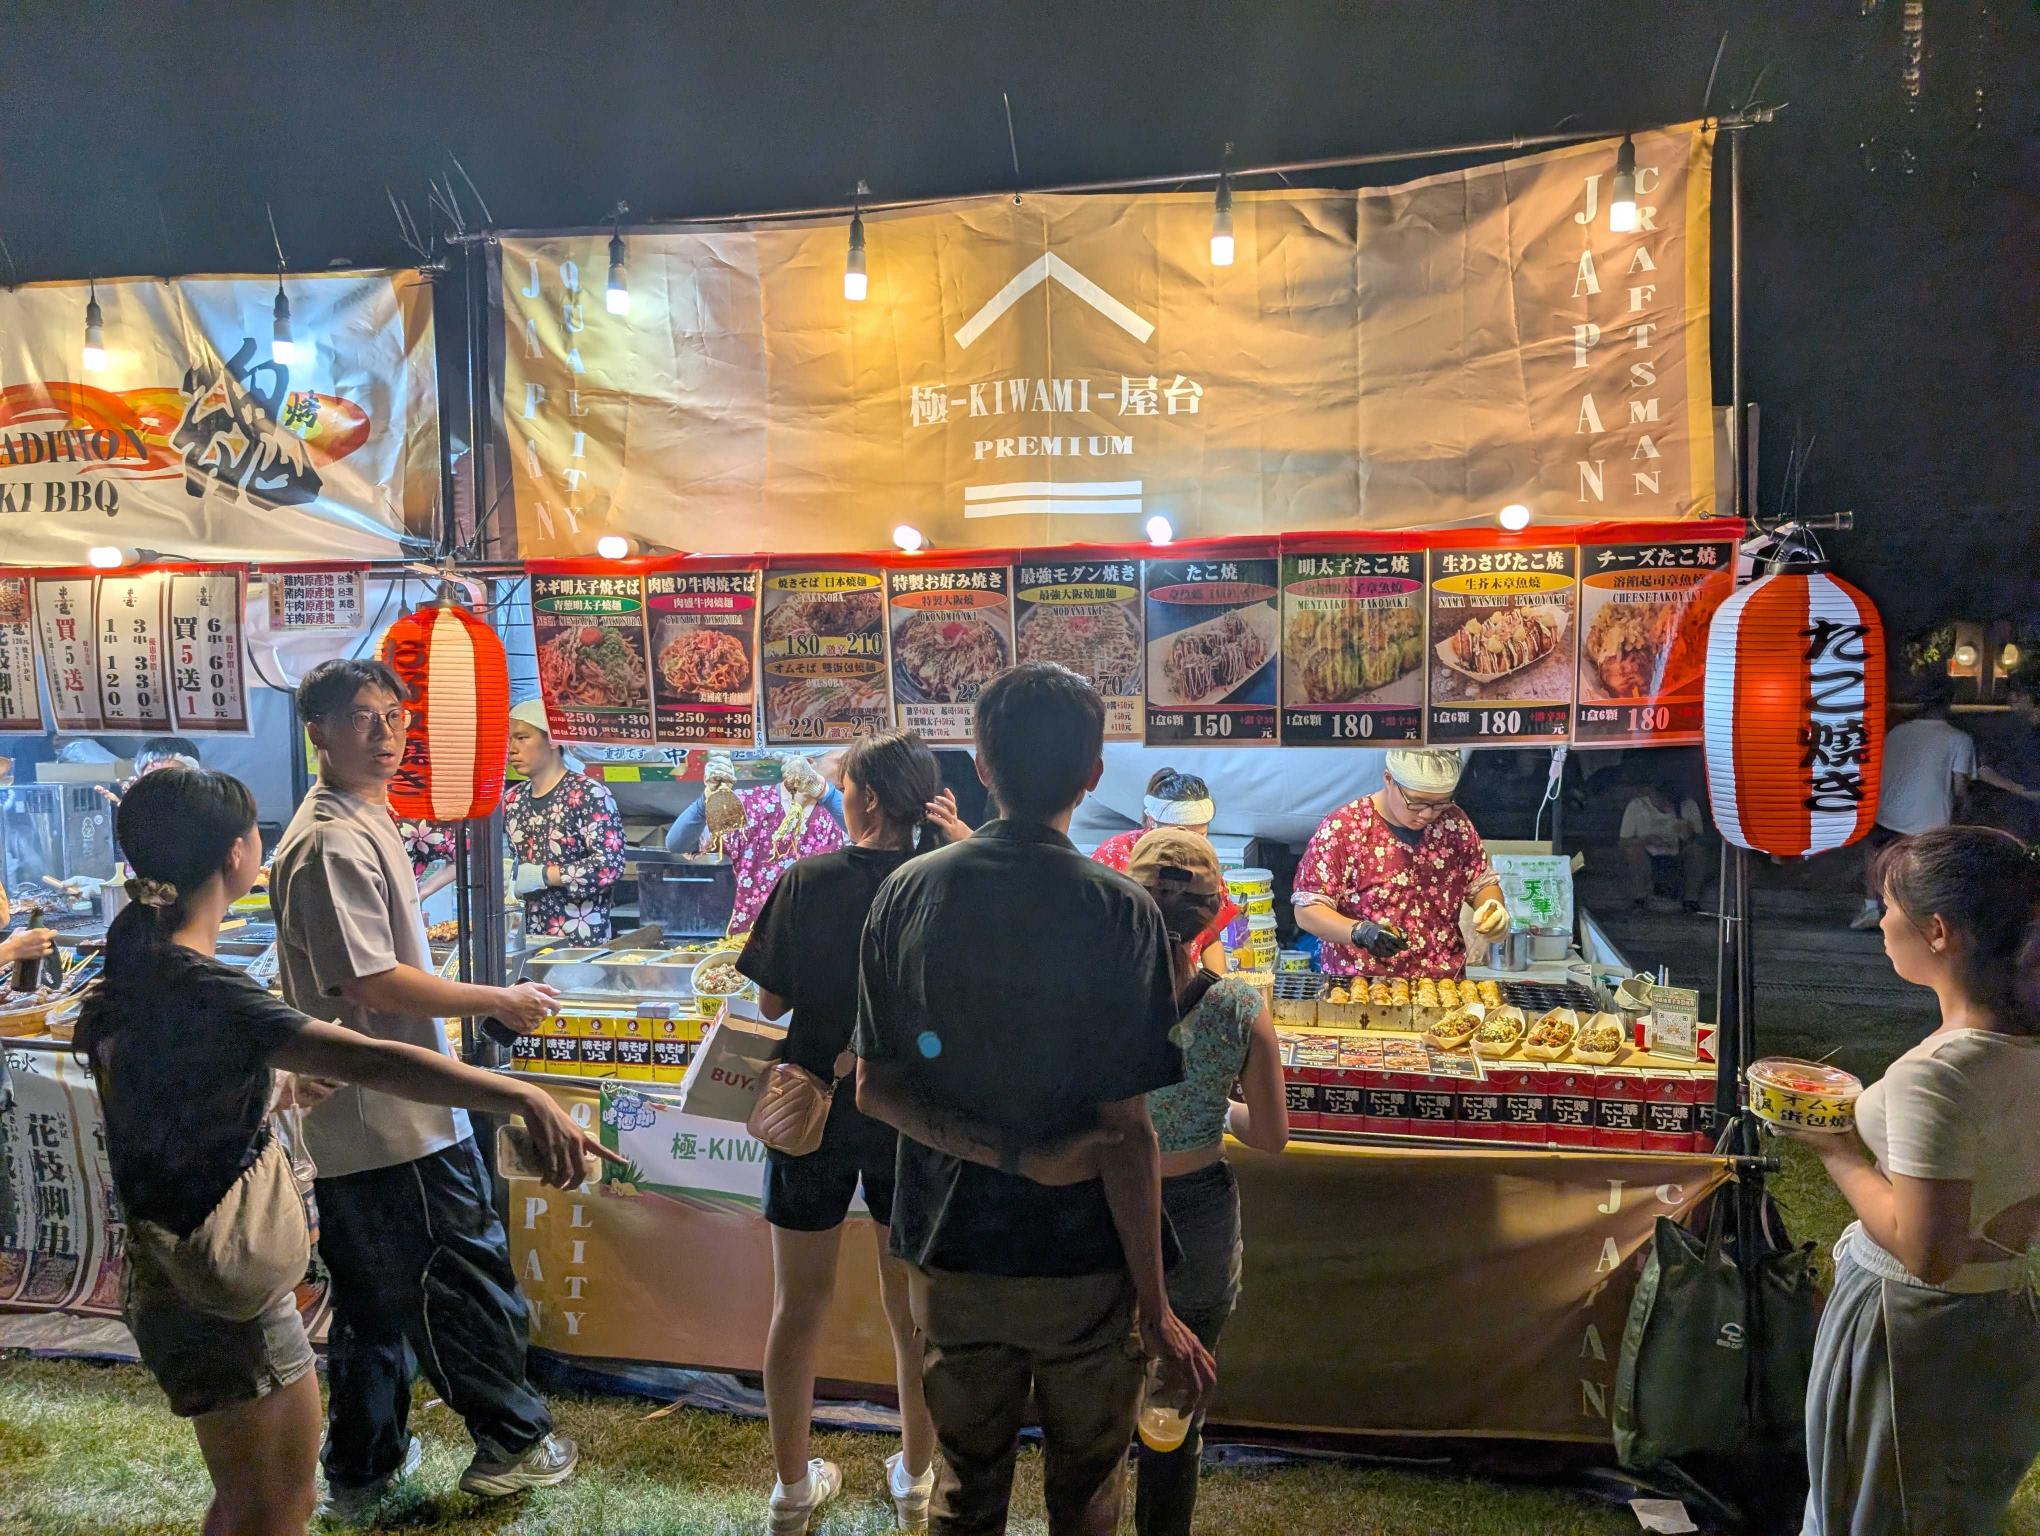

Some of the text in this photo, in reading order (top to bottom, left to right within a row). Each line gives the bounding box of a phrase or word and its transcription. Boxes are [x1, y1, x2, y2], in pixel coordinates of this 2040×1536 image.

[1571, 174, 1603, 502] JAPAN
[1627, 167, 1661, 495] CRAFTSMAN
[520, 259, 556, 540] JAPAN
[560, 261, 590, 535] QUALITY
[973, 435, 1135, 460] PREMIUM
[41, 480, 120, 517] BBQ
[1298, 558, 1409, 575] 明太子たこ焼
[1443, 551, 1565, 573] 生わさびたこ焼
[1597, 547, 1717, 567] チーズたこ焼
[778, 577, 820, 588] 焼きそば
[892, 572, 1002, 591] 特製お好み焼き
[1020, 565, 1135, 584] 最強モダン焼き
[1186, 563, 1238, 581] たこ焼
[535, 579, 640, 596] ネギ明太子焼そば
[648, 576, 755, 594] 肉盛り牛肉焼そば
[786, 634, 820, 656] 180
[847, 633, 883, 656] 210
[174, 616, 201, 715] 買5送1
[957, 683, 980, 702] 22
[617, 714, 649, 725] +30
[724, 713, 751, 725] +30
[789, 718, 825, 738] 220
[1192, 714, 1232, 737] 150
[1331, 714, 1373, 738] 180
[1478, 710, 1521, 735] 180
[1627, 707, 1669, 731] 180
[711, 1066, 753, 1091] BUY
[1783, 1094, 1855, 1111] オムそ
